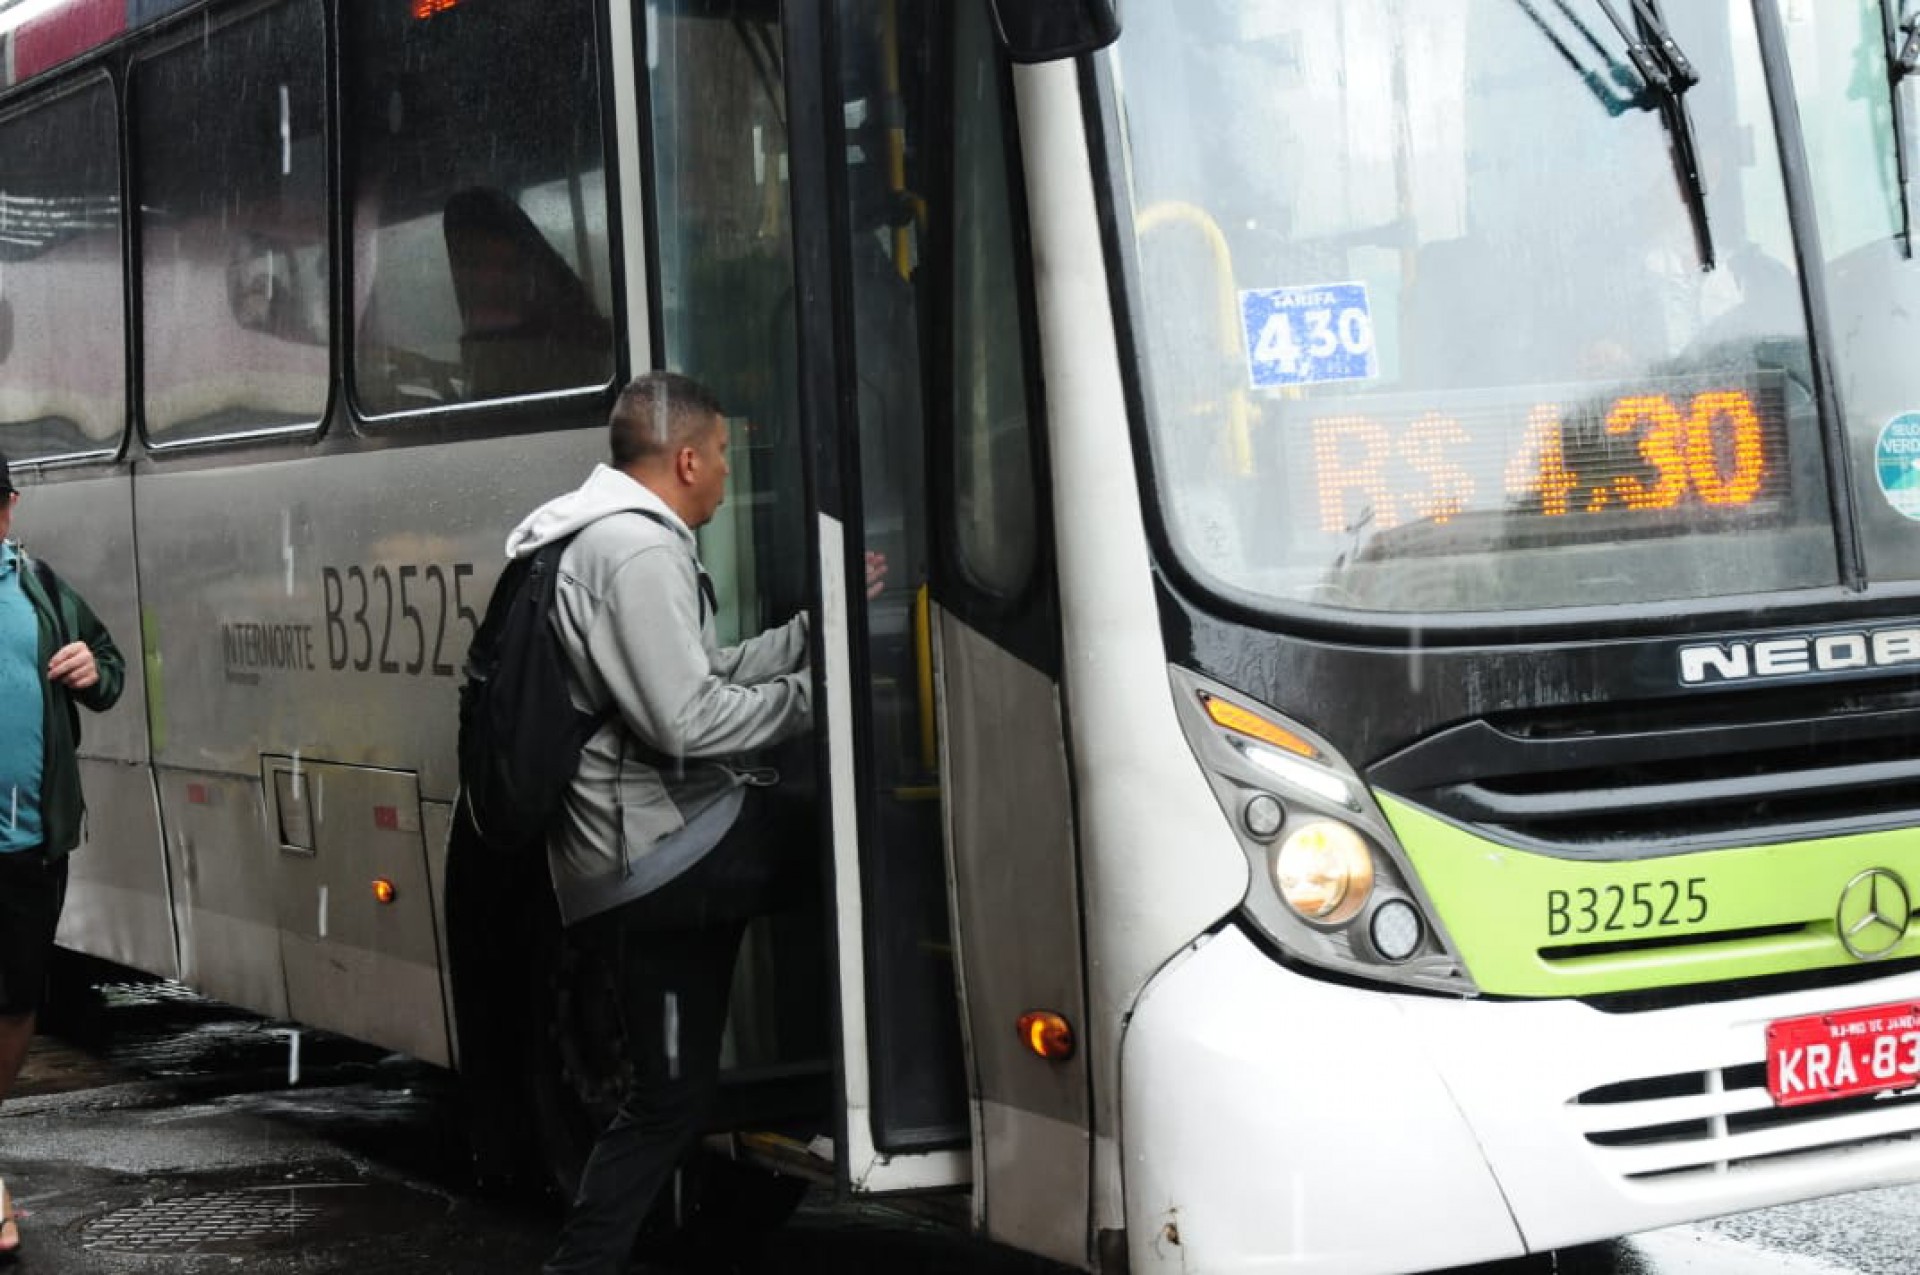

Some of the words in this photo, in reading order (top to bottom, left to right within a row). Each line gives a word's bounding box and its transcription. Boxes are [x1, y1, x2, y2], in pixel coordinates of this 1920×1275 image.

[1272, 291, 1336, 307] TARIFA
[1313, 411, 1476, 532] R$
[222, 622, 316, 671] INTERNORTE
[1679, 629, 1920, 682] NEOB
[1548, 877, 1708, 936] B32525
